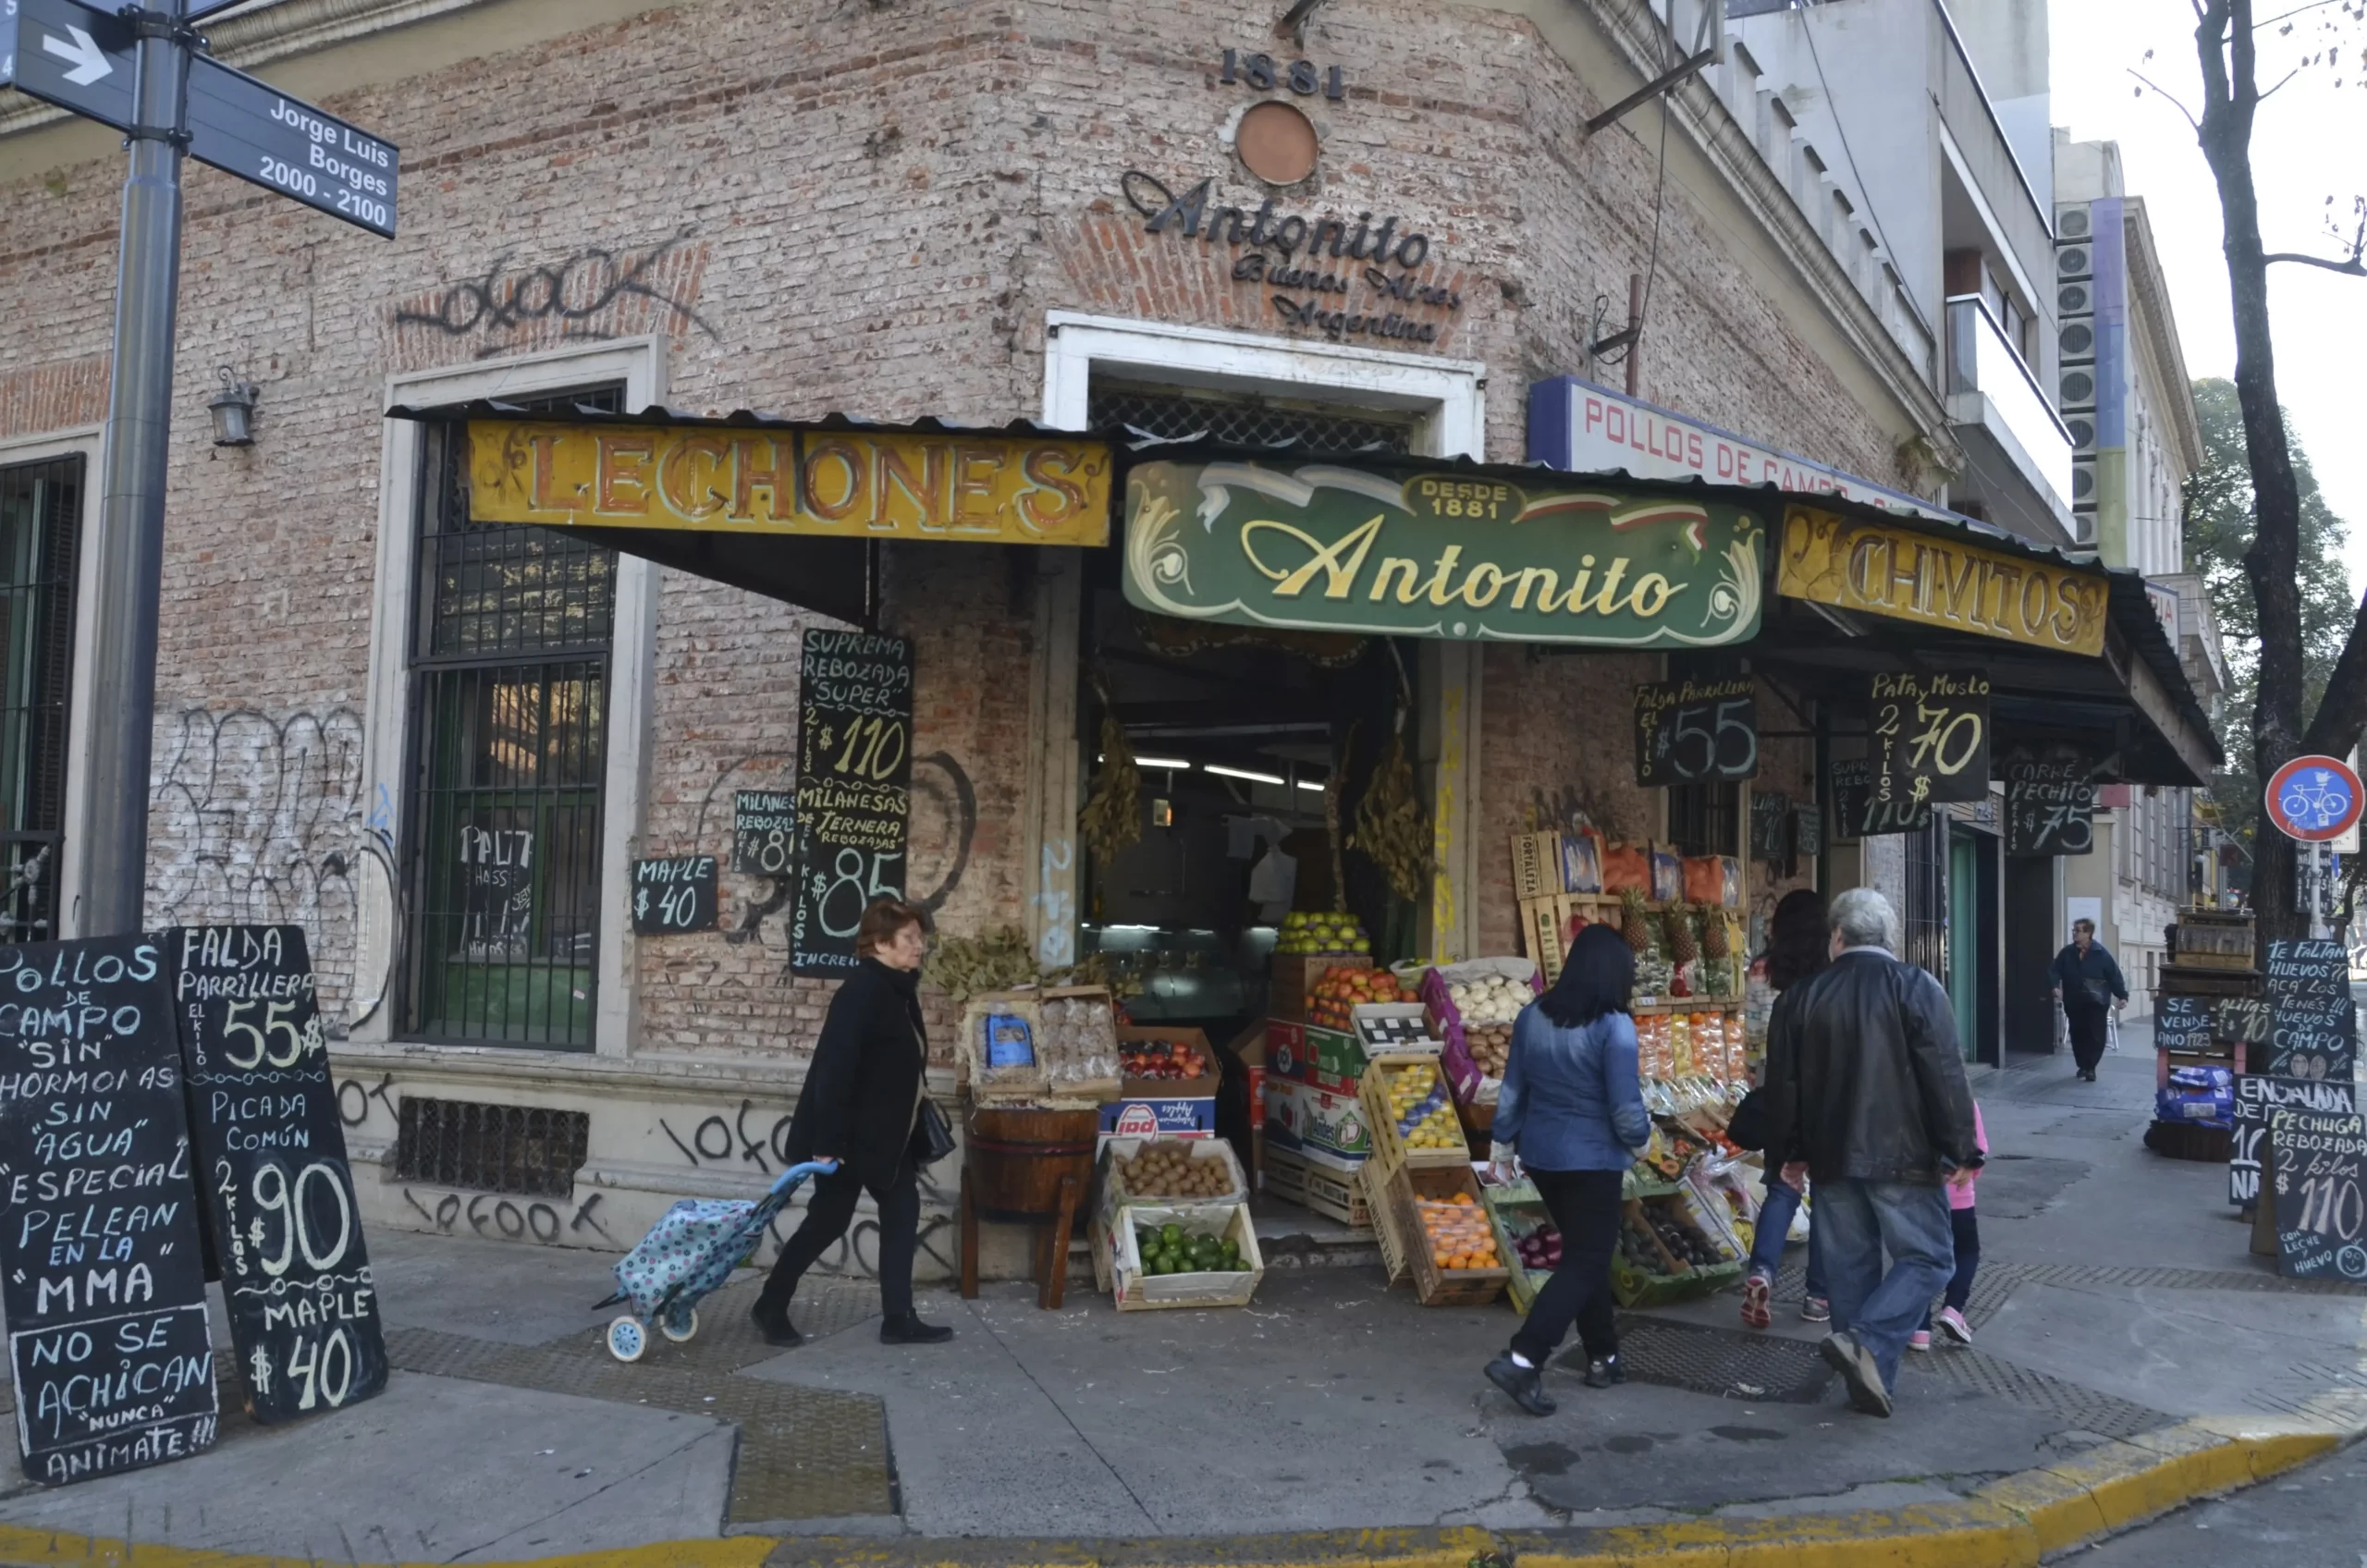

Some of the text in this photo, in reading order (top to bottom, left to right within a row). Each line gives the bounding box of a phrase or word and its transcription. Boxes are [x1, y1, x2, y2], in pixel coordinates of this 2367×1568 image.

[1221, 47, 1343, 100] 1881
[271, 98, 389, 168] Jorge Luis
[309, 143, 387, 197] Borges
[260, 155, 316, 198] 2000
[337, 189, 386, 227] 2100
[1120, 170, 1429, 269] Antonito
[1233, 253, 1463, 310] Buenos Aires
[1270, 294, 1437, 343] Argentina
[1584, 398, 1704, 470] POLLOS
[1717, 443, 1748, 485] DE
[528, 435, 1086, 533] LECHONES
[1420, 479, 1508, 502] DESDE
[1430, 498, 1500, 521] 1881
[1241, 514, 1688, 619] Antonito
[1851, 529, 2084, 646] CHIVITOS
[803, 631, 905, 661] SUPREMA
[803, 654, 911, 688] REBOZADA
[1634, 685, 1676, 711] FALDA
[1875, 704, 1901, 735] 2
[818, 715, 904, 780] $ 110
[1674, 698, 1758, 778] 55
[1908, 704, 1982, 776] 70
[1907, 775, 1932, 803] $
[820, 810, 901, 838] TERNERA
[2033, 805, 2091, 850] 75
[475, 865, 509, 888] HASS
[637, 856, 714, 883] MAPLE
[811, 871, 827, 902] $
[633, 884, 695, 927] $ 40
[182, 927, 282, 970] FALDA
[2268, 939, 2347, 960] TE FALTAN
[61, 990, 92, 1009] DE
[178, 971, 317, 1003] PARRILLERA
[2307, 979, 2337, 996] LOS
[0, 1002, 141, 1040] CAMPO
[188, 1003, 206, 1018] EL
[2166, 998, 2194, 1013] SE
[2161, 1014, 2210, 1032] VENDE
[2240, 1013, 2269, 1043] 10
[2298, 1023, 2314, 1032] DE
[2273, 1027, 2345, 1052] CAMPO
[44, 1101, 113, 1126] SIN
[212, 1091, 307, 1124] PICADA
[2233, 1098, 2261, 1119] DE
[2271, 1109, 2362, 1135] PECHUGA
[226, 1122, 310, 1151] COMÚN
[2272, 1130, 2367, 1157] REBOZADA
[2278, 1147, 2300, 1172] 2
[215, 1159, 238, 1194] 2
[248, 1162, 350, 1276] $ 90
[2275, 1172, 2365, 1240] $ 110
[19, 1202, 179, 1249] PELEAN
[227, 1194, 249, 1276] KILOS
[2280, 1229, 2301, 1243] CON
[50, 1236, 134, 1266] EN LA
[2284, 1234, 2321, 1254] LECHE
[2294, 1249, 2333, 1273] HUEVO
[264, 1290, 373, 1331] MAPLE
[32, 1316, 175, 1366] NO SE
[250, 1328, 351, 1411] $ 40
[38, 1351, 213, 1439] ACHICAN
